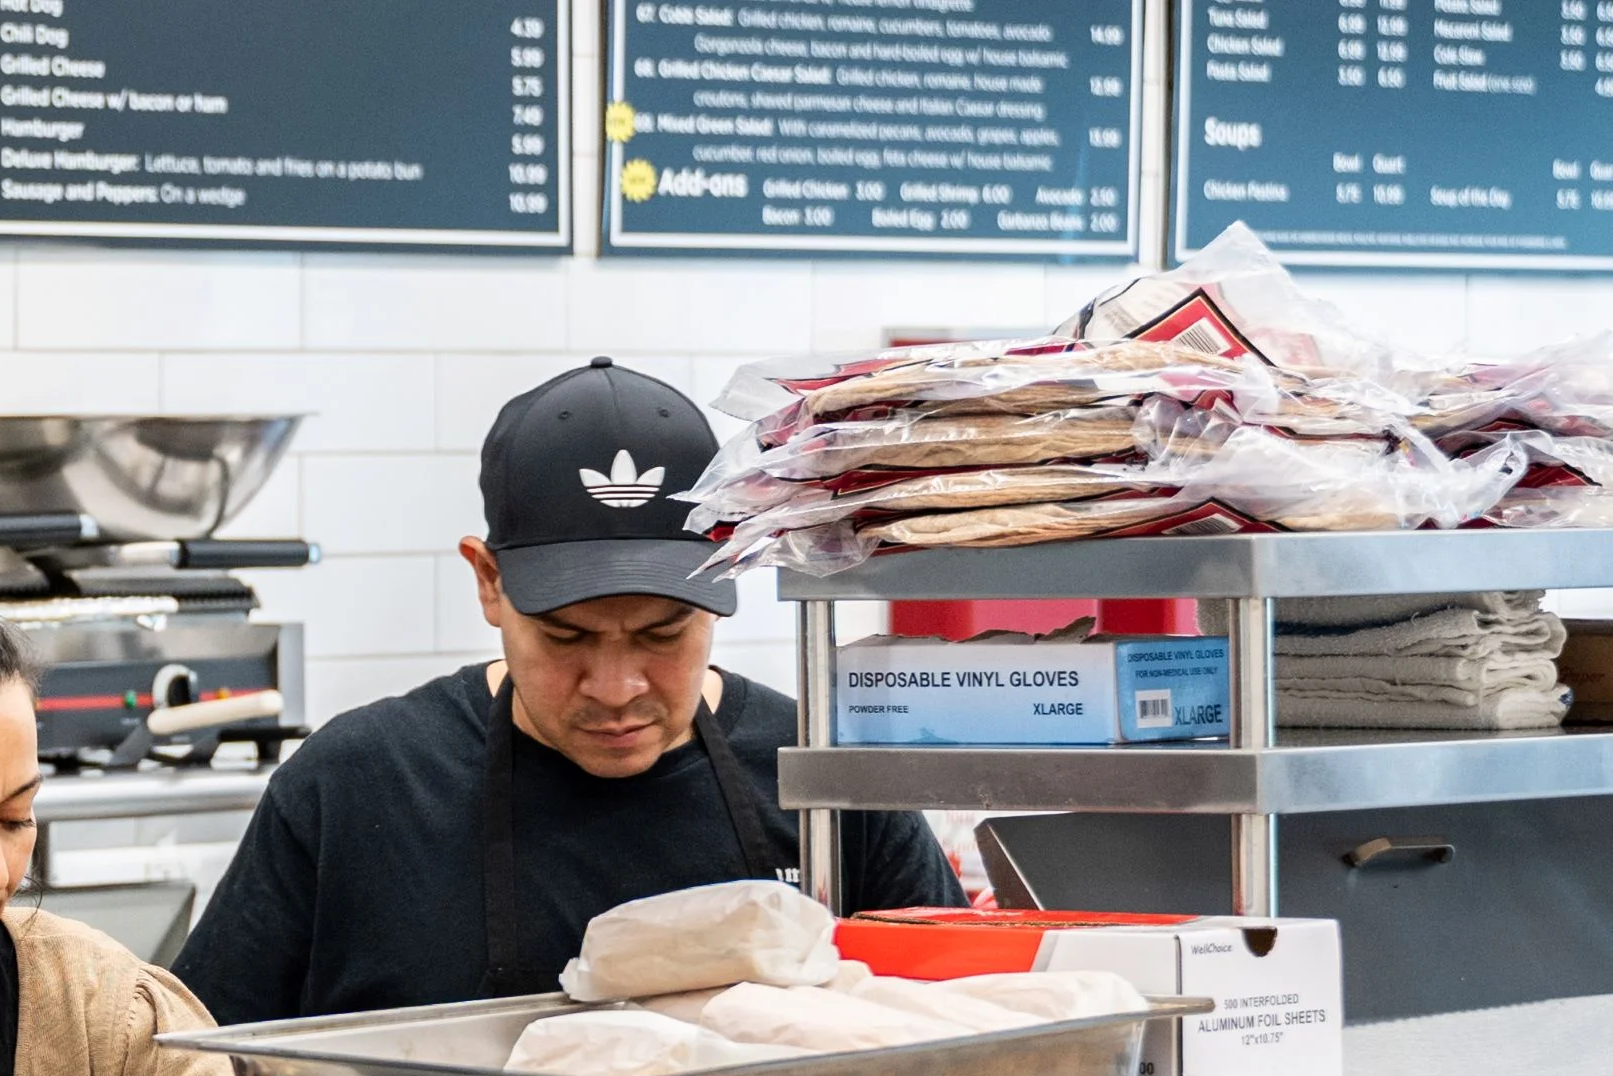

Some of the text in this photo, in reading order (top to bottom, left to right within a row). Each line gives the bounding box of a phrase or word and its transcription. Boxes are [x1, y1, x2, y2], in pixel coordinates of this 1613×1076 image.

[0, 23, 34, 43] Chili
[35, 24, 69, 48] Dog
[0, 54, 51, 76] Grilled
[51, 56, 106, 78] Cheese
[0, 85, 51, 107] Grilled
[51, 87, 105, 109] Cheese
[0, 119, 85, 142] Hamburger
[1204, 116, 1262, 151] Soups
[255, 158, 283, 176] and
[1, 179, 64, 203] Sausage
[65, 182, 95, 201] and
[657, 167, 749, 198] Add-ons
[1128, 648, 1224, 663] DISPOSABLE VINYL GLOVES
[848, 670, 1079, 688] DISPOSABLE VINYL GLOVES
[848, 704, 909, 715] POWDER FREE
[1033, 702, 1083, 716] XLARGE
[1174, 704, 1223, 726] XLARGE
[1191, 942, 1233, 955] WellChoice
[1224, 993, 1299, 1011] 500 INTERFOLDED
[1198, 1009, 1326, 1034] ALUMINUM FOIL SHEETS
